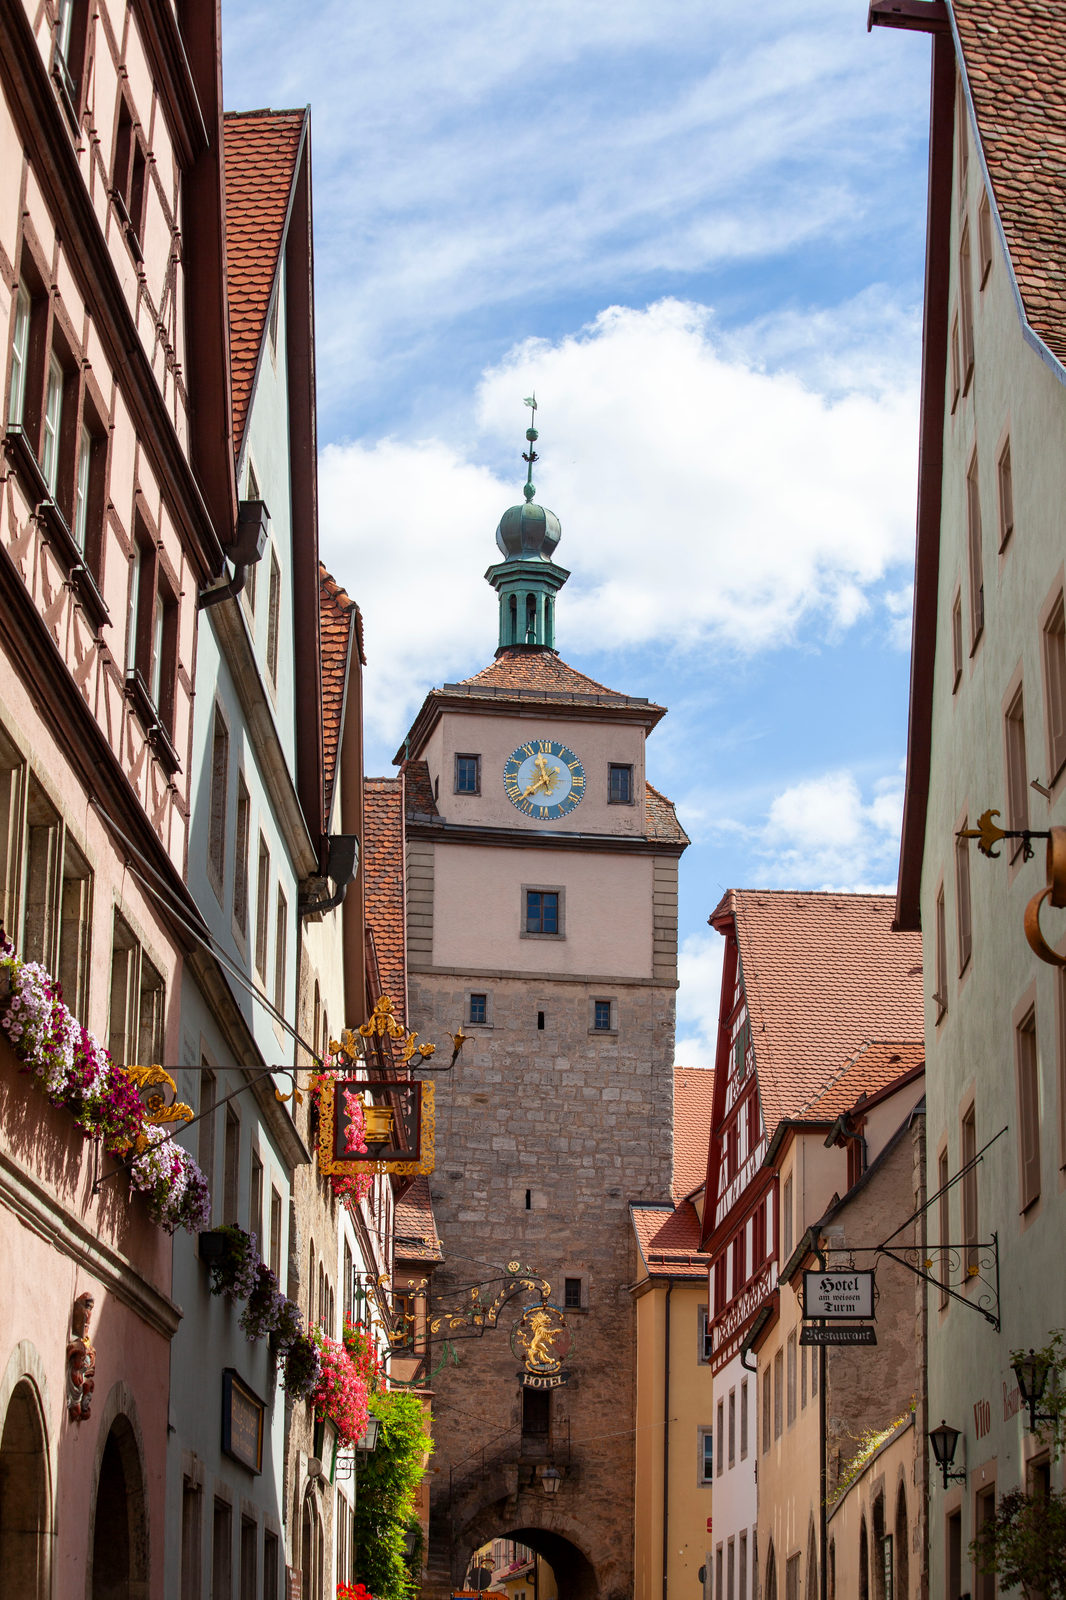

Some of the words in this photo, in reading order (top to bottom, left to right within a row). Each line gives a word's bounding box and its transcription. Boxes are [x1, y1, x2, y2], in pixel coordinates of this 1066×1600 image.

[819, 1277, 859, 1293] Hotel
[833, 1293, 861, 1301] weissen
[824, 1302, 856, 1312] Turm
[806, 1329, 871, 1341] Restaurant
[523, 1374, 566, 1388] HOTEL
